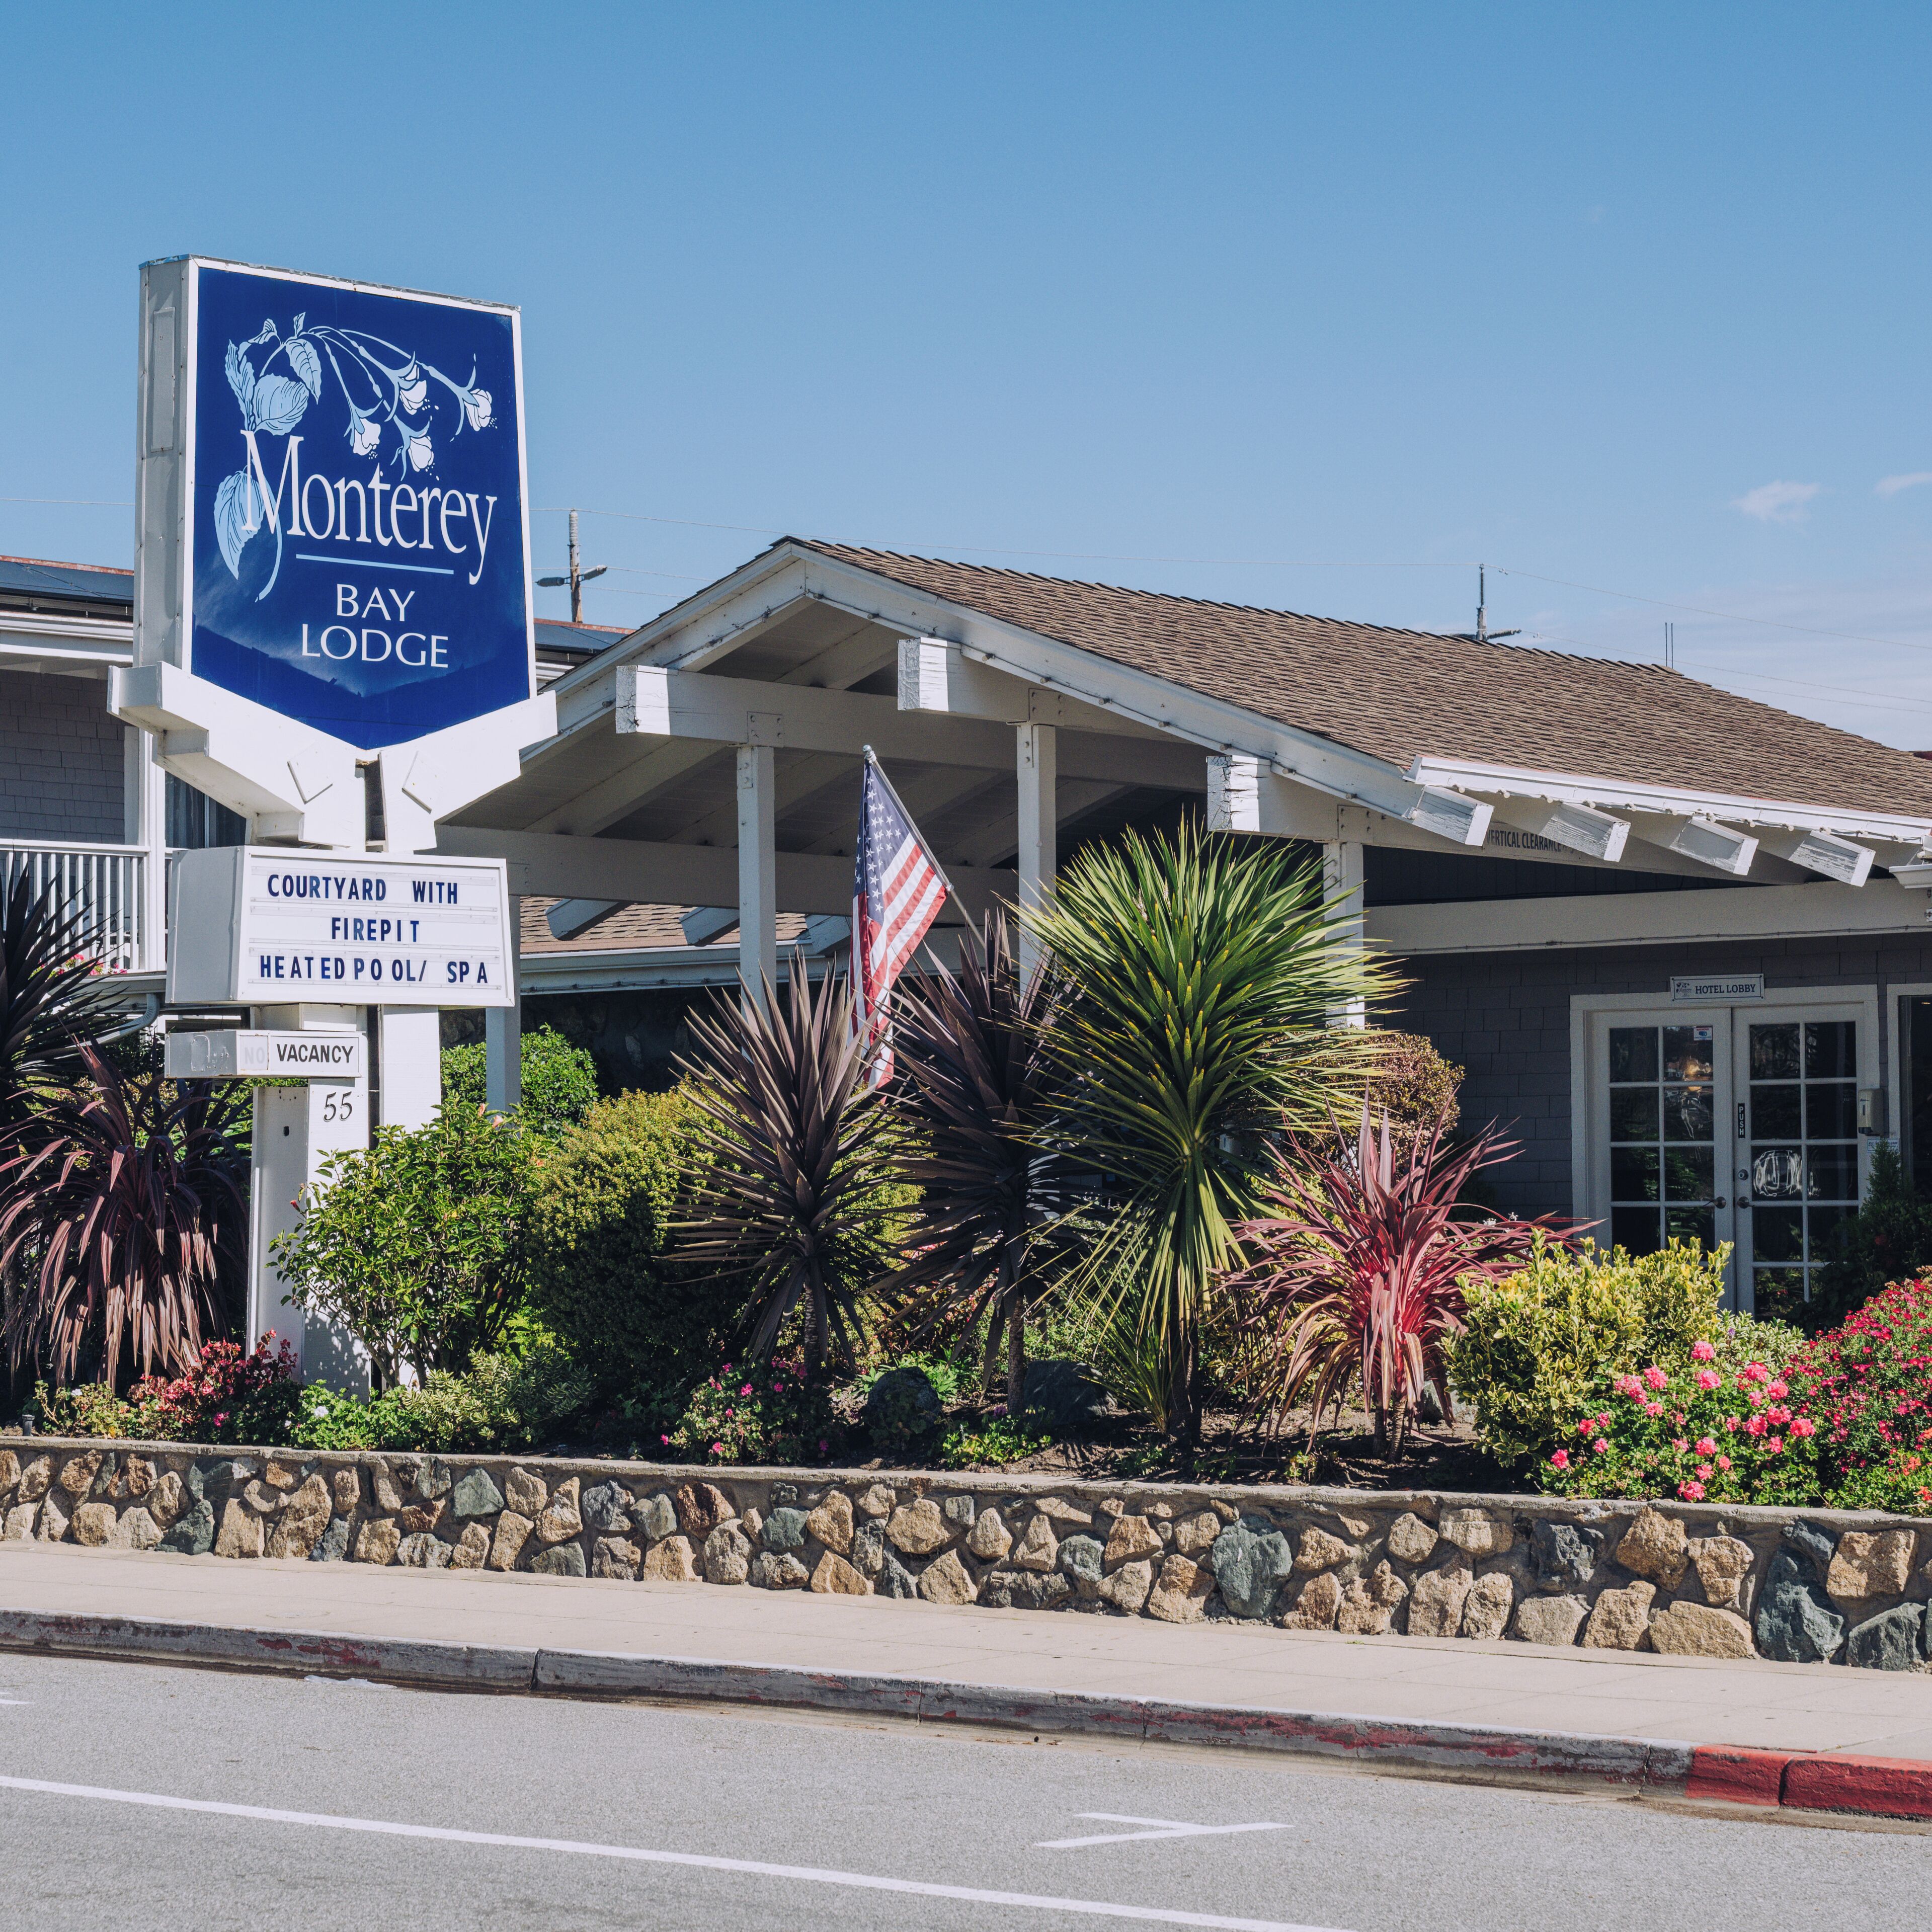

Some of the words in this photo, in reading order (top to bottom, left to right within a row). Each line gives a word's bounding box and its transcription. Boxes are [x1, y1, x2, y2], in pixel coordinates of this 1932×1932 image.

[240, 430, 498, 585] Monterey
[337, 584, 415, 621] BAY
[302, 623, 448, 668] LODGE
[1486, 830, 1520, 848] VERTICAL
[1521, 832, 1561, 852] CLEARANCE
[268, 874, 386, 901] COURTYARD
[412, 880, 457, 904] WITH
[332, 917, 419, 942] FIREPIT
[447, 961, 488, 984] SPA
[1695, 985, 1724, 994] HOTEL
[1726, 984, 1756, 994] LOBBY
[244, 1046, 266, 1065] NO
[277, 1043, 354, 1063] VACANCY
[324, 1091, 353, 1121] 55
